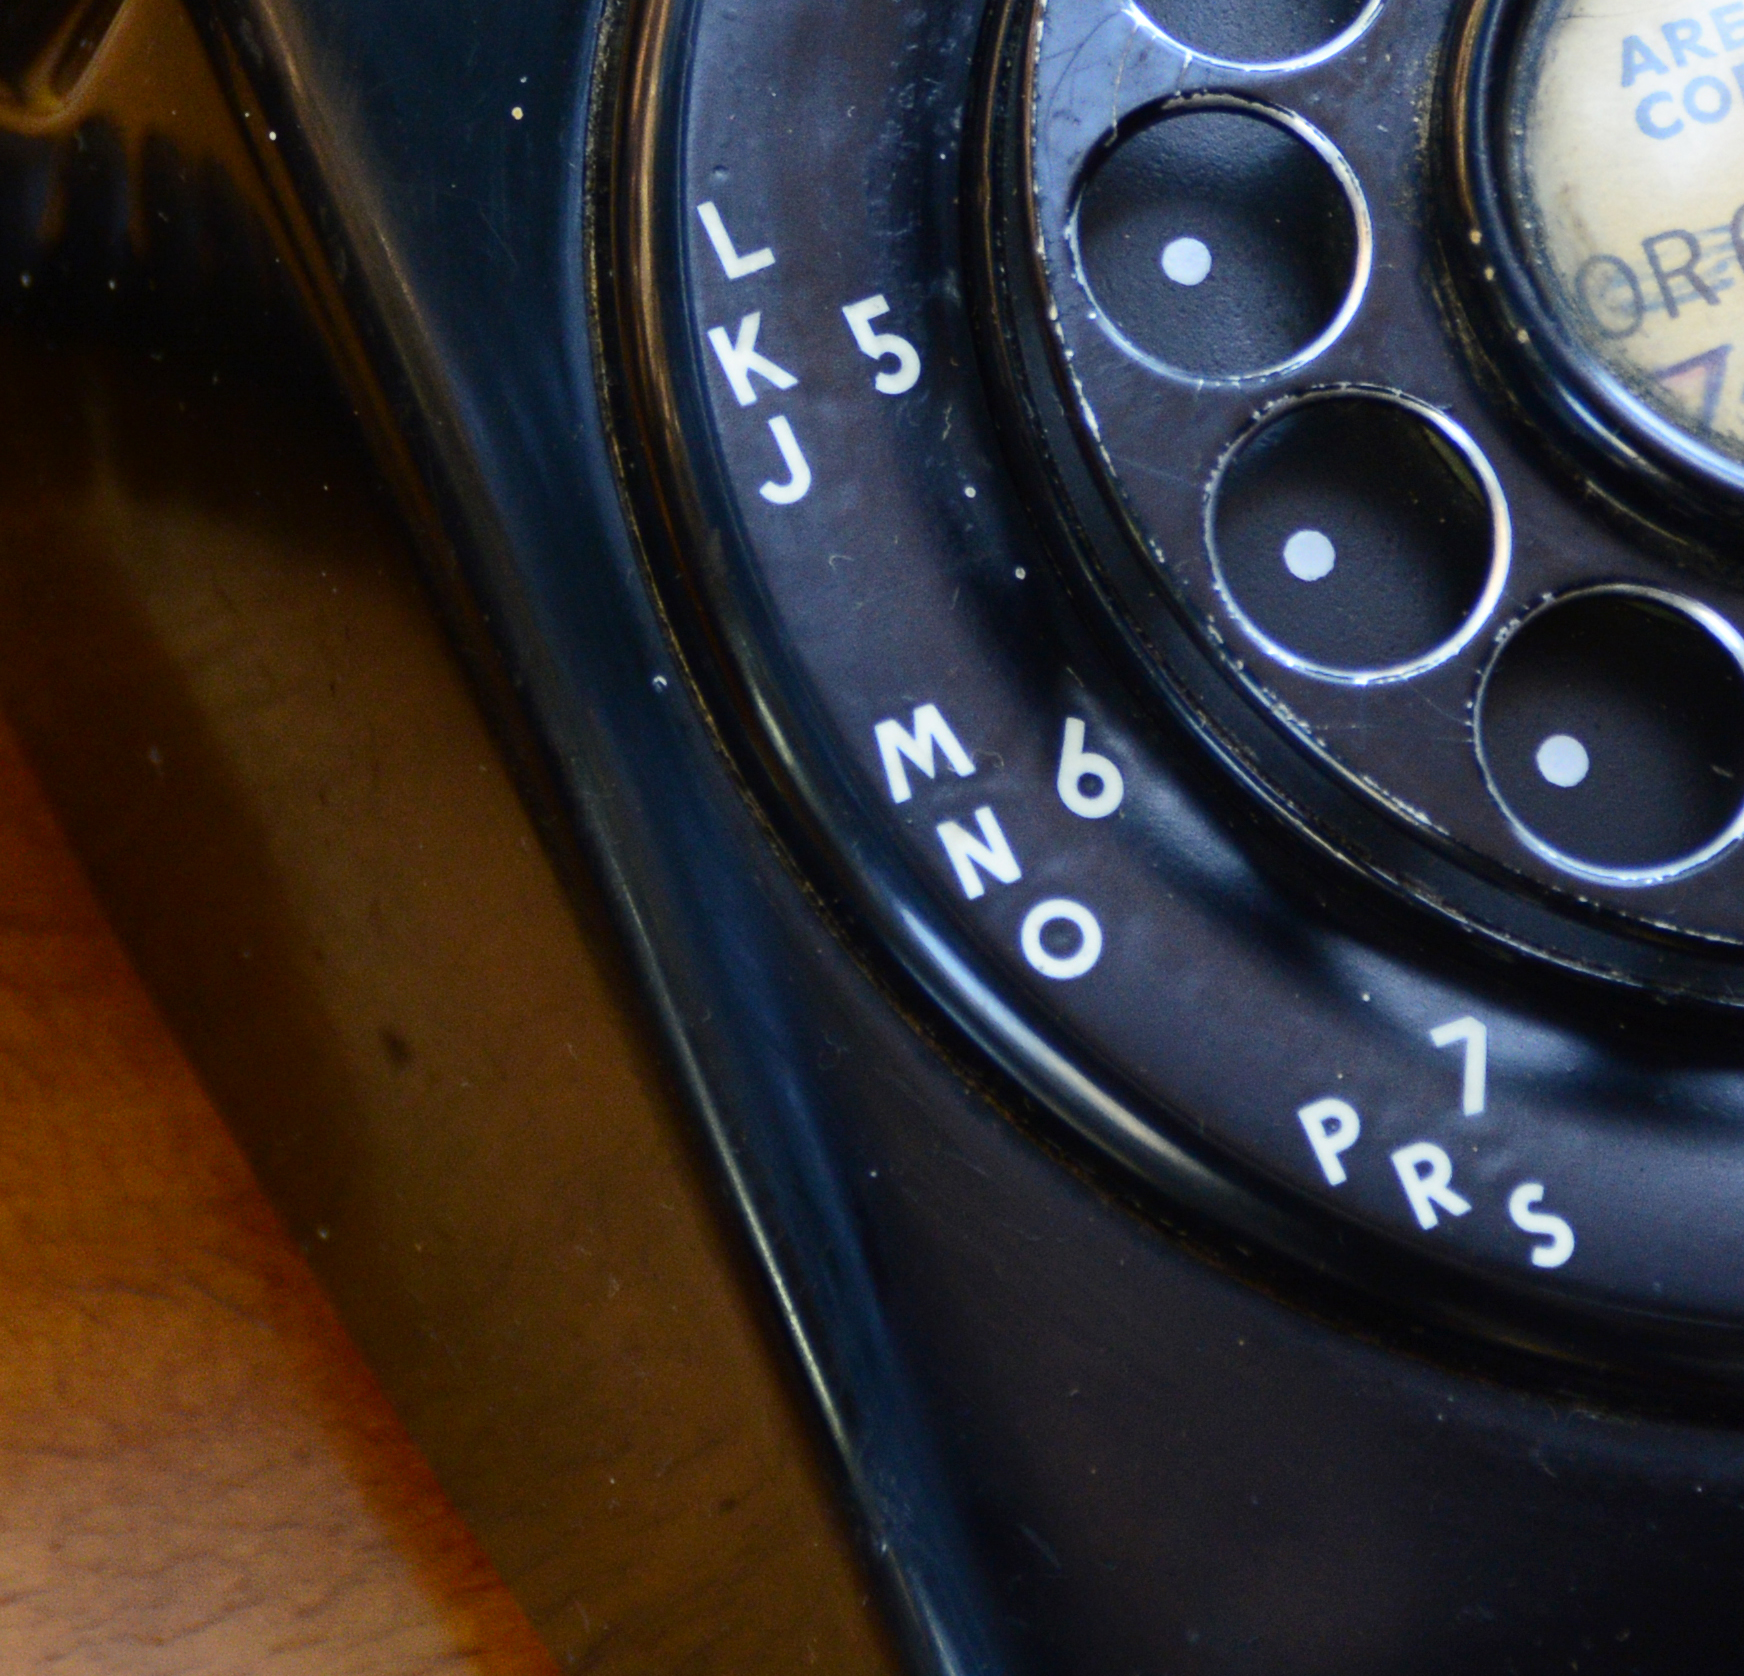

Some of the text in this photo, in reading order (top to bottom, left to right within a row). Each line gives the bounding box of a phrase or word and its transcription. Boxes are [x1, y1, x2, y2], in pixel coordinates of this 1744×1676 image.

[841, 294, 921, 395] 5
[1057, 717, 1125, 819] 6
[874, 702, 1104, 980] MNO
[1429, 1014, 1489, 1117] 7
[1297, 1097, 1575, 1268] PRS
